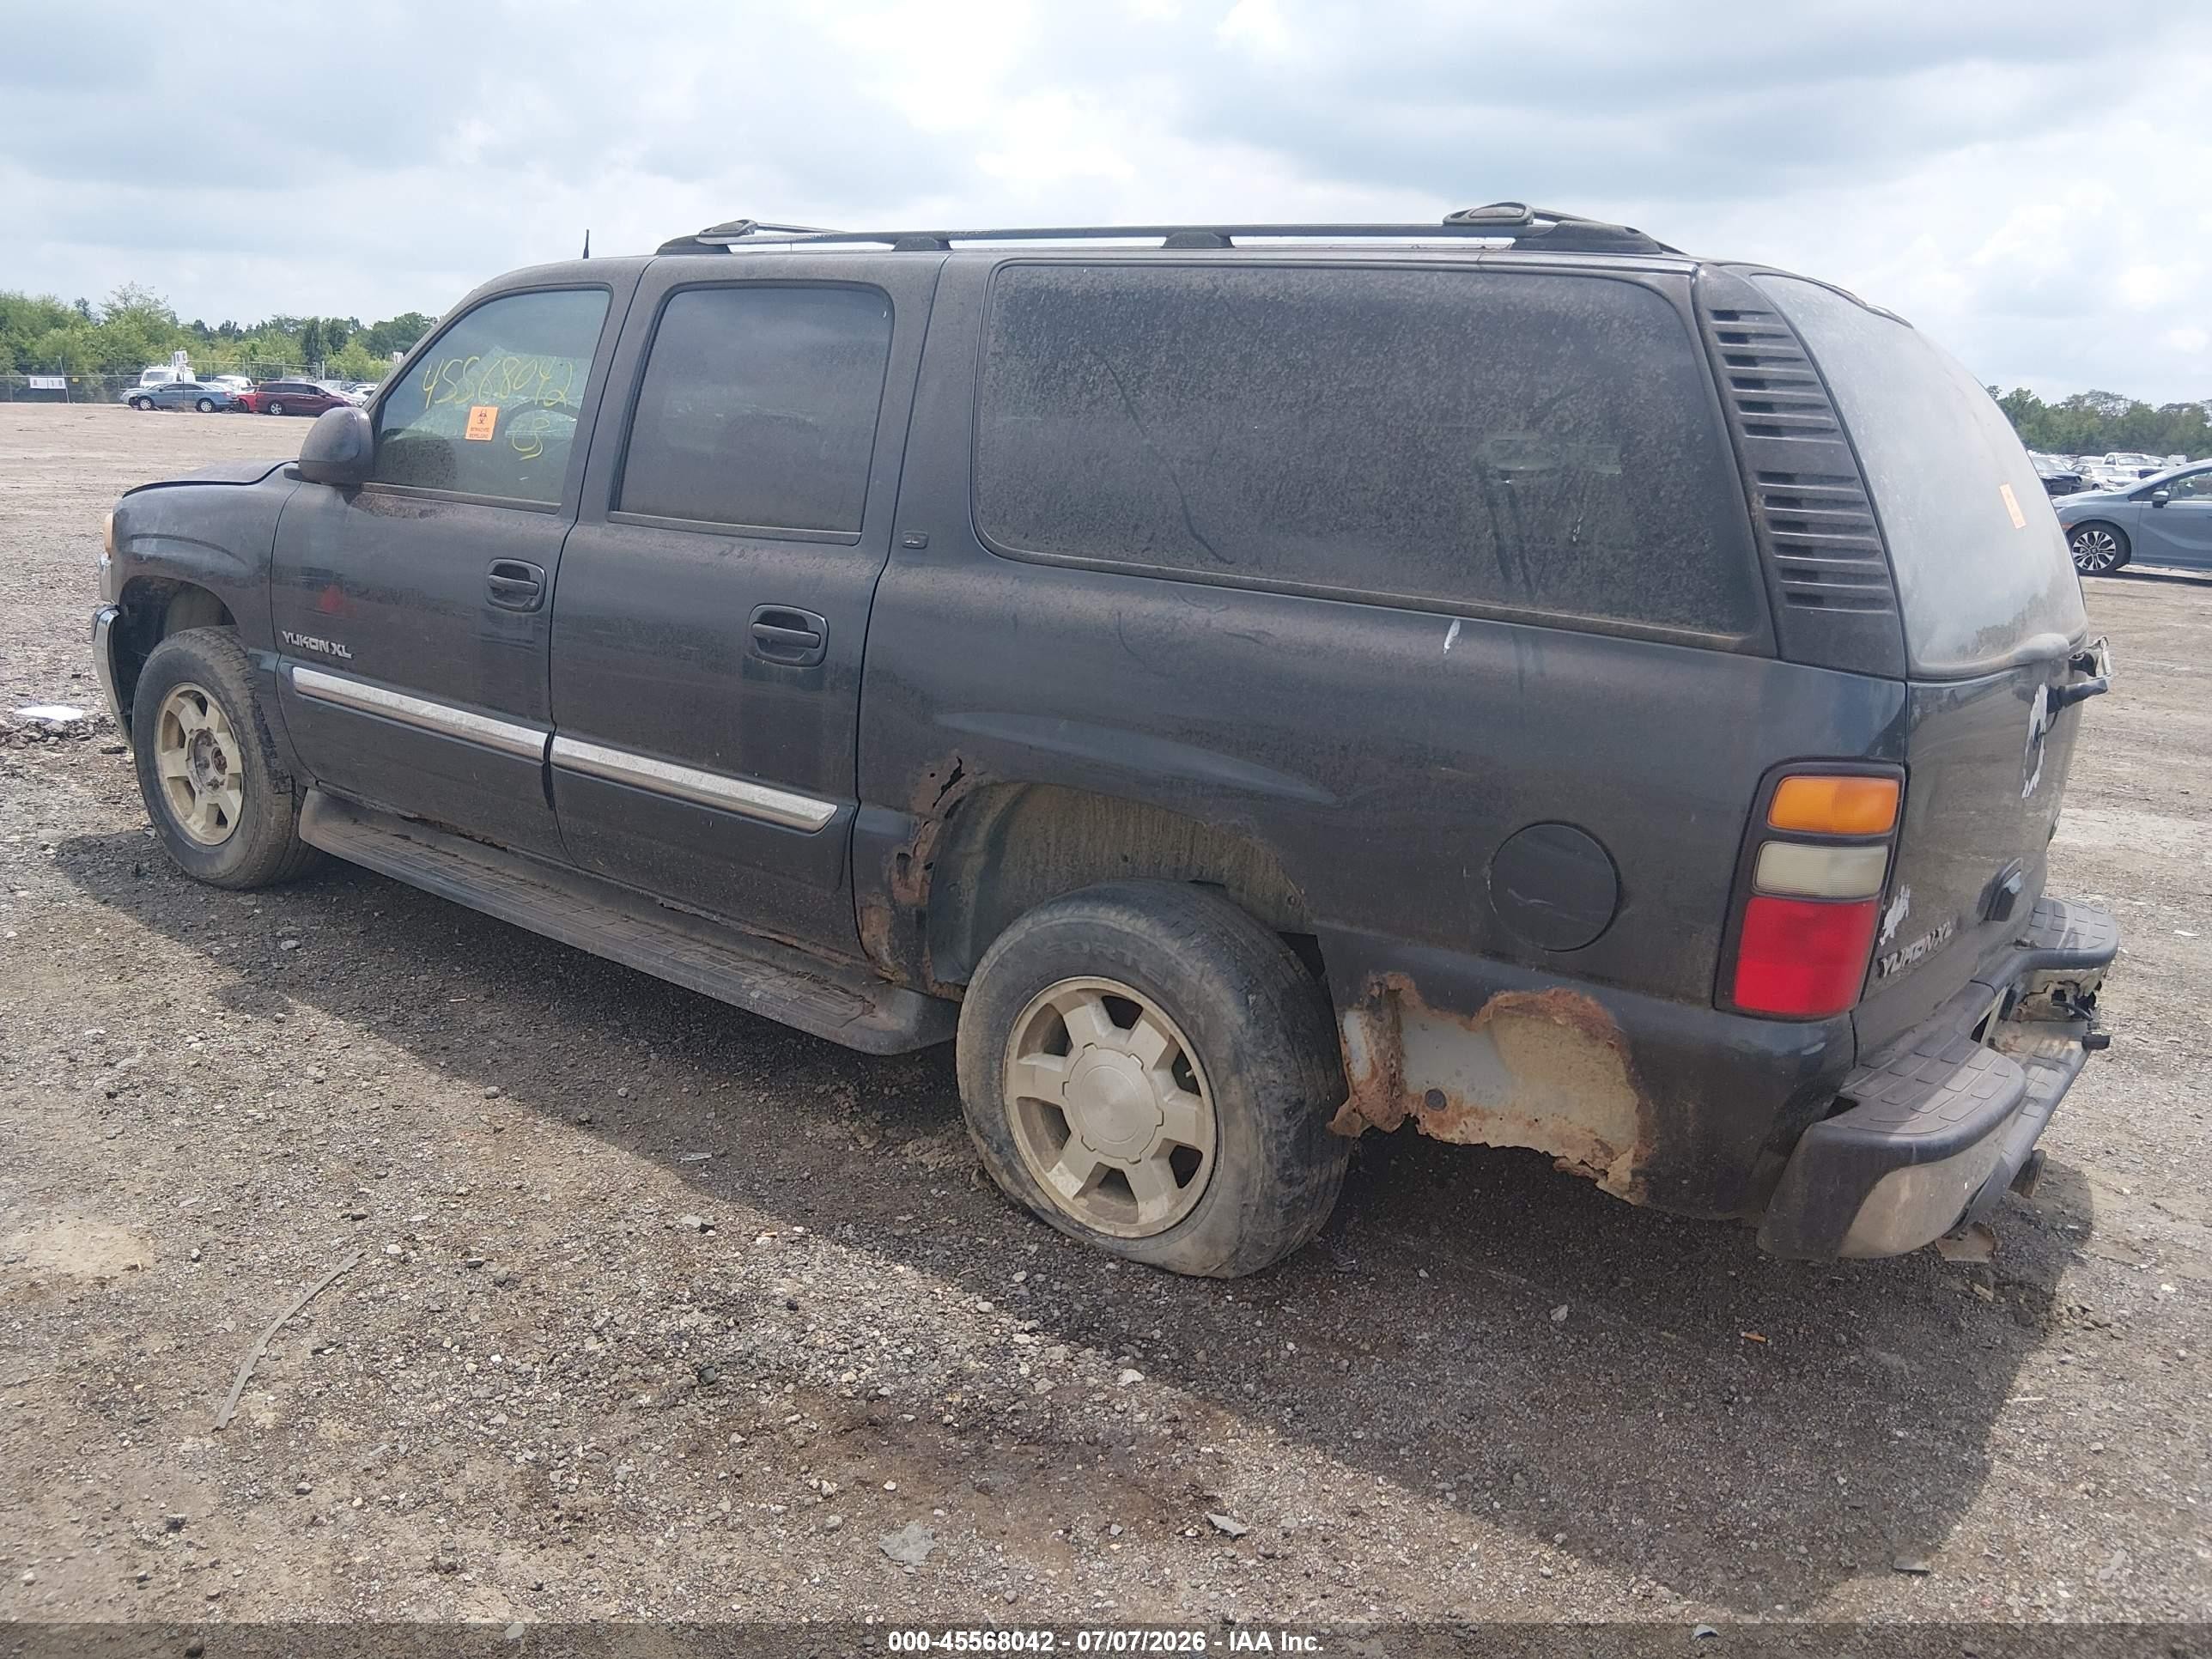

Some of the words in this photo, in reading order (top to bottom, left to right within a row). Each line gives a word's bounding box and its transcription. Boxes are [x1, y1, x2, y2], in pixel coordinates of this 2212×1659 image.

[422, 356, 574, 409] 45568042
[282, 630, 330, 653] YUKON
[331, 642, 354, 659] XL
[1881, 929, 1936, 978] YUKON
[1935, 921, 1953, 948] XL
